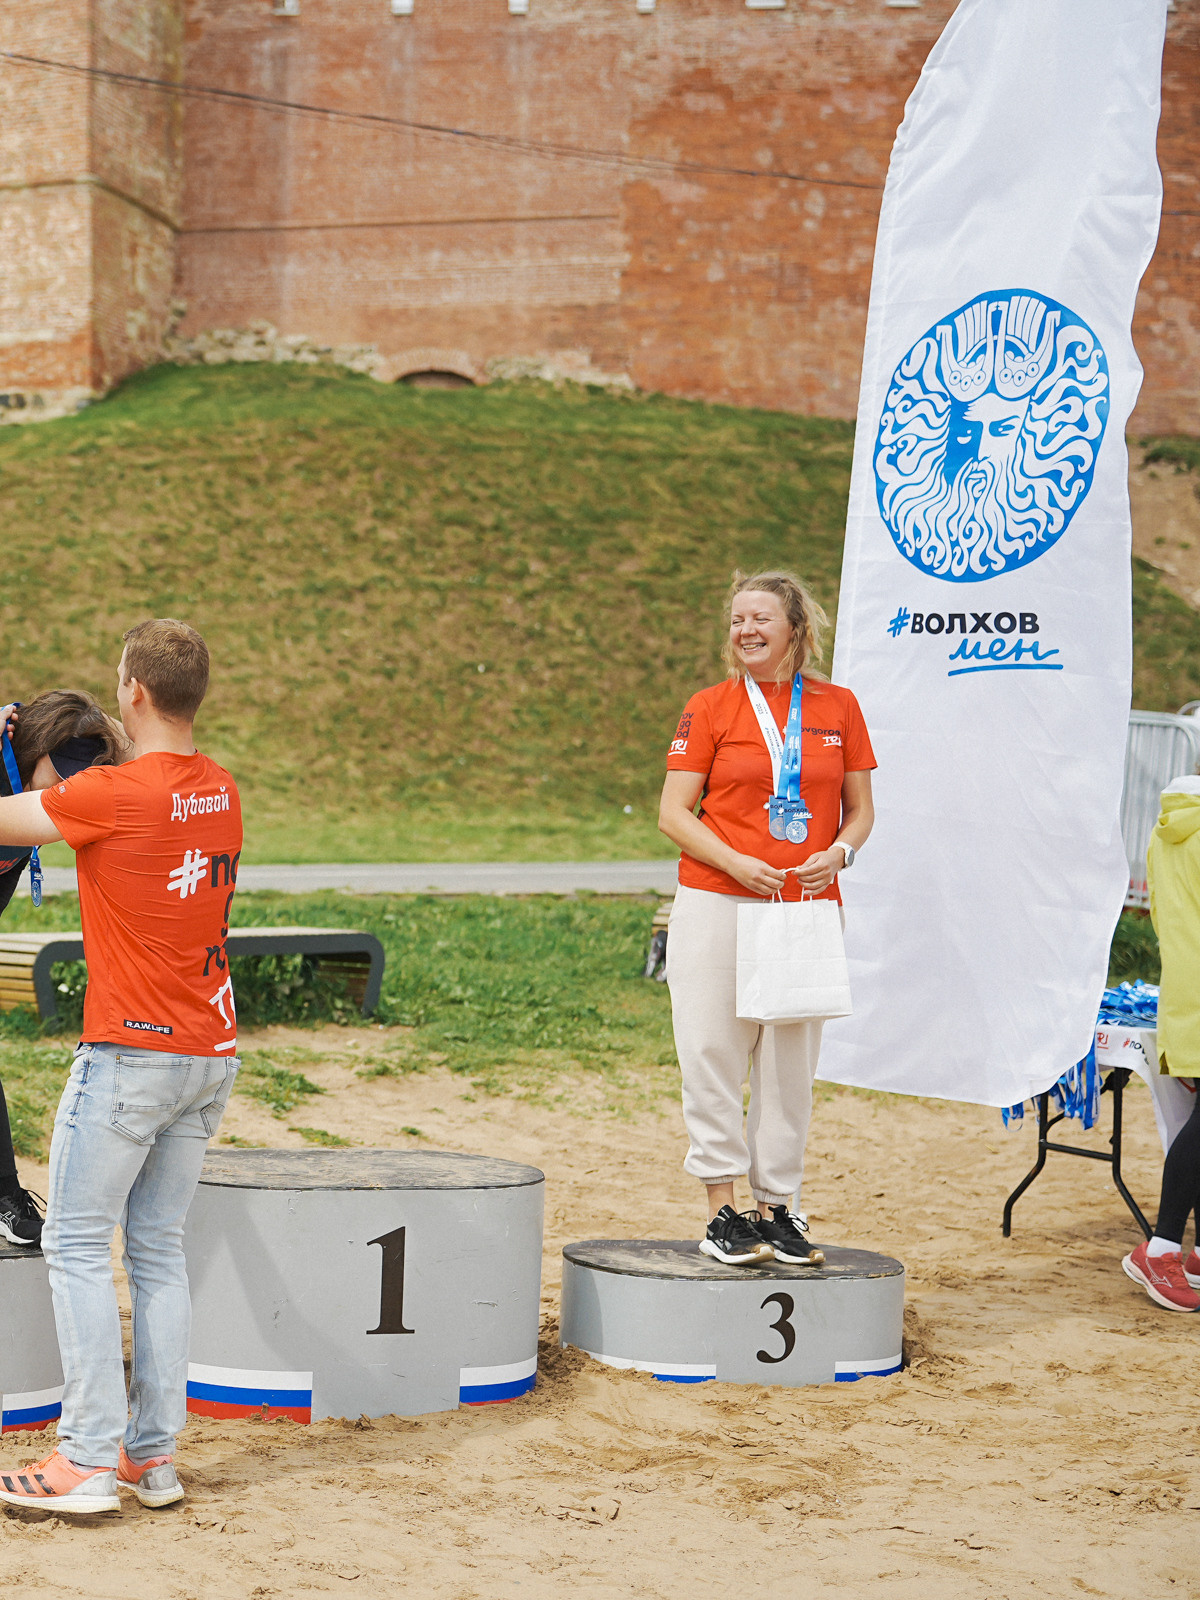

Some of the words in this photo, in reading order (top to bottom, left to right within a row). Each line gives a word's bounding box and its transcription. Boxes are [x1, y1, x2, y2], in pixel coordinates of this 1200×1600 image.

[887, 607, 1040, 638] #ВОЛХОВ
[948, 638, 1060, 663] мен
[676, 727, 690, 738] od
[171, 786, 230, 823] Дубовой
[366, 1226, 415, 1335] 1
[757, 1292, 795, 1364] 3
